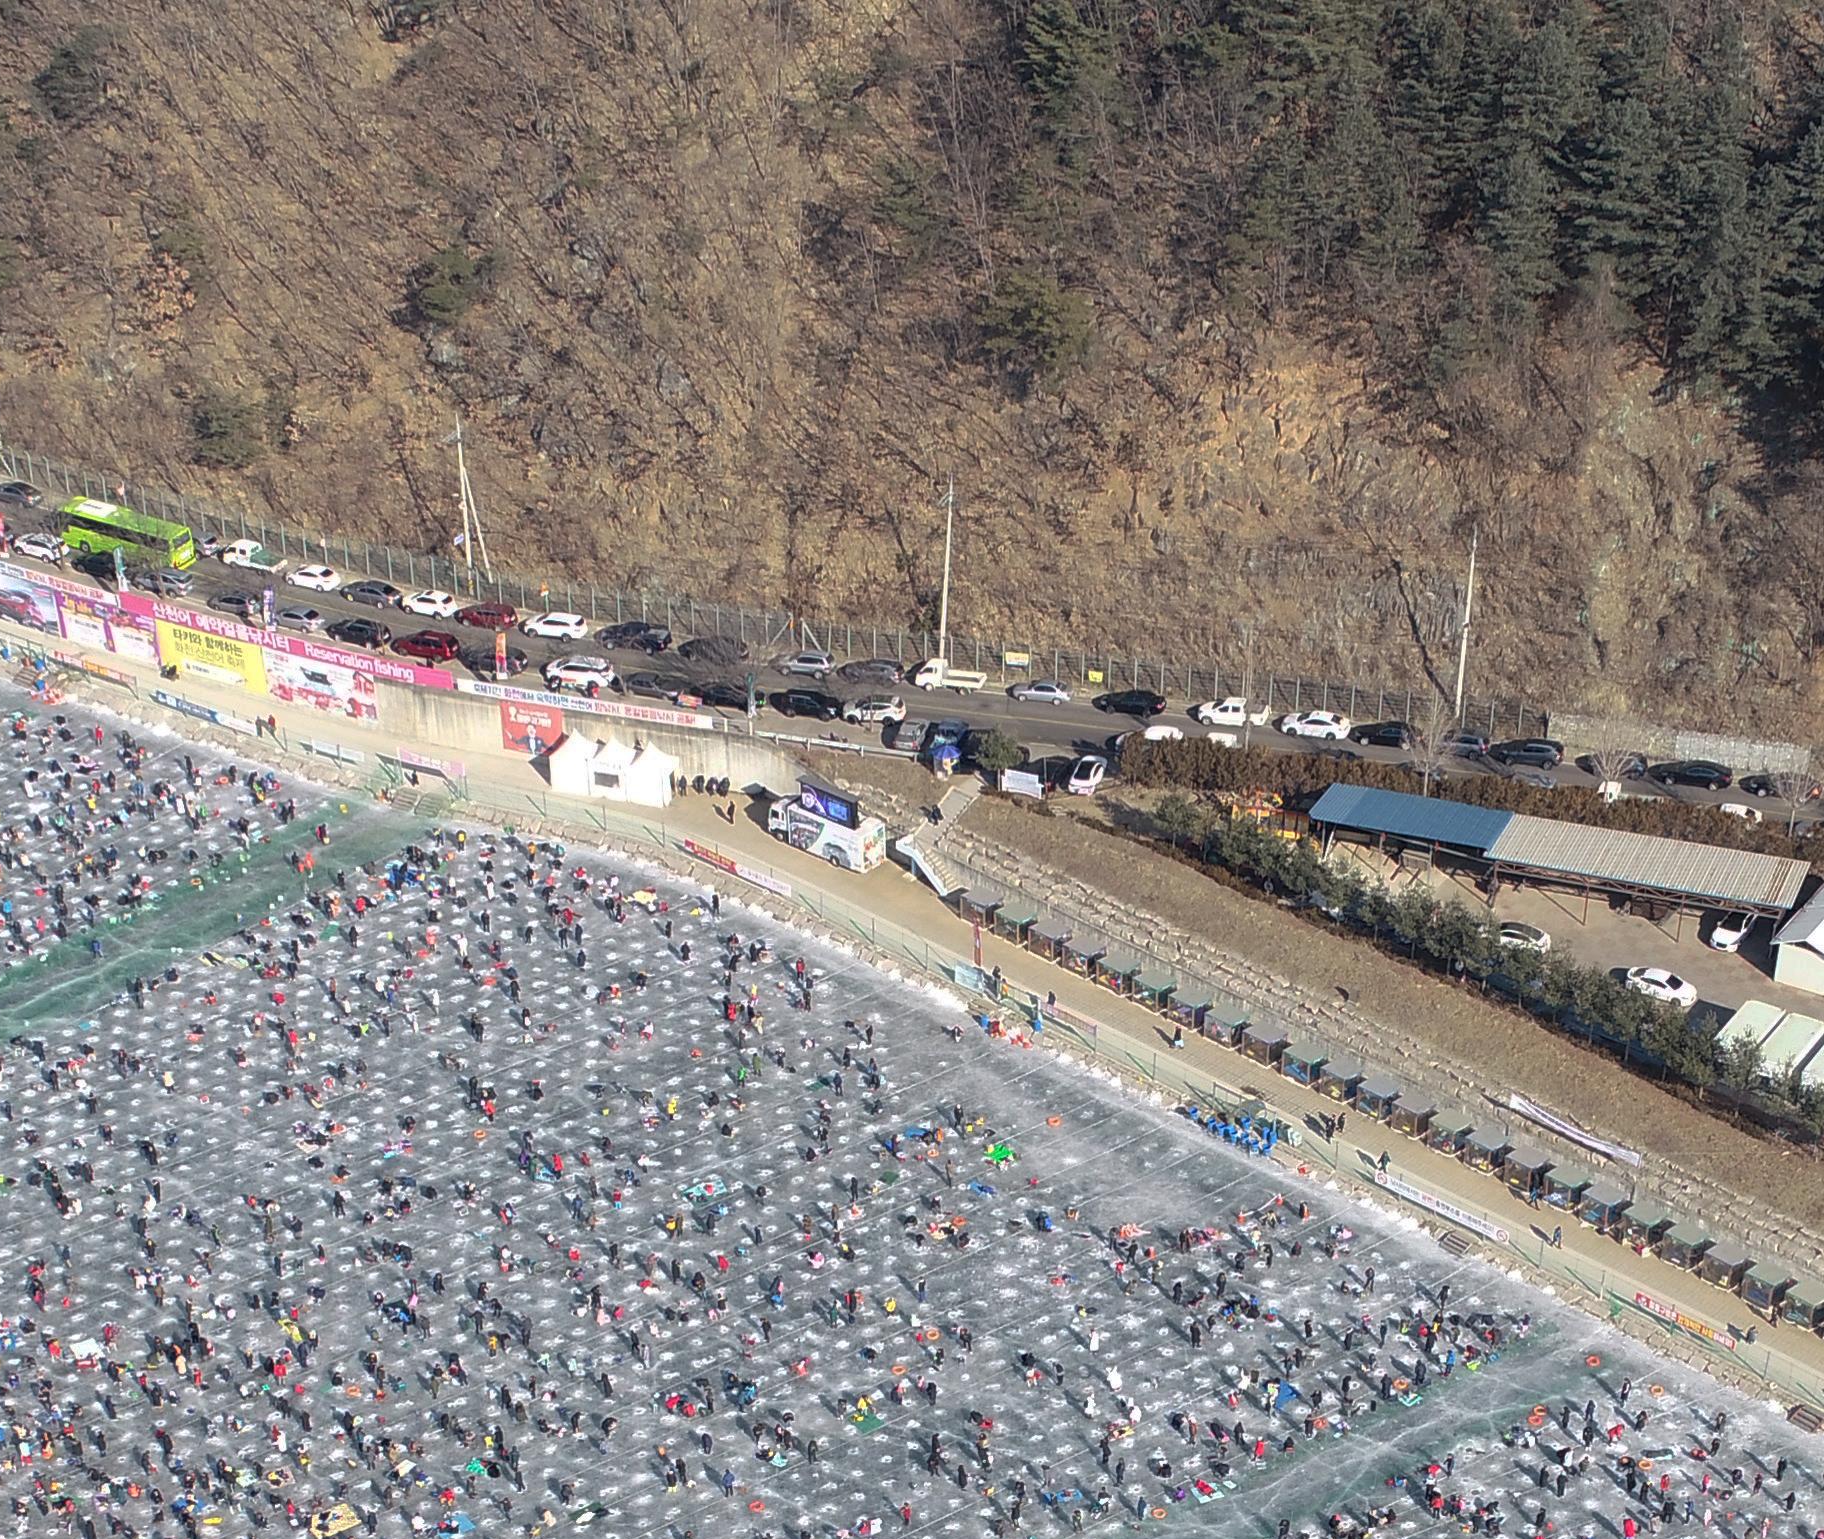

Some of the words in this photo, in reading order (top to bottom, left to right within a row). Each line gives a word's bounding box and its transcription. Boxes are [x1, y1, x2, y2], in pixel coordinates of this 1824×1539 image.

[152, 602, 192, 627] 산천어
[205, 636, 244, 658] 함께하는
[304, 641, 374, 671] Reservation
[374, 659, 415, 683] fishing
